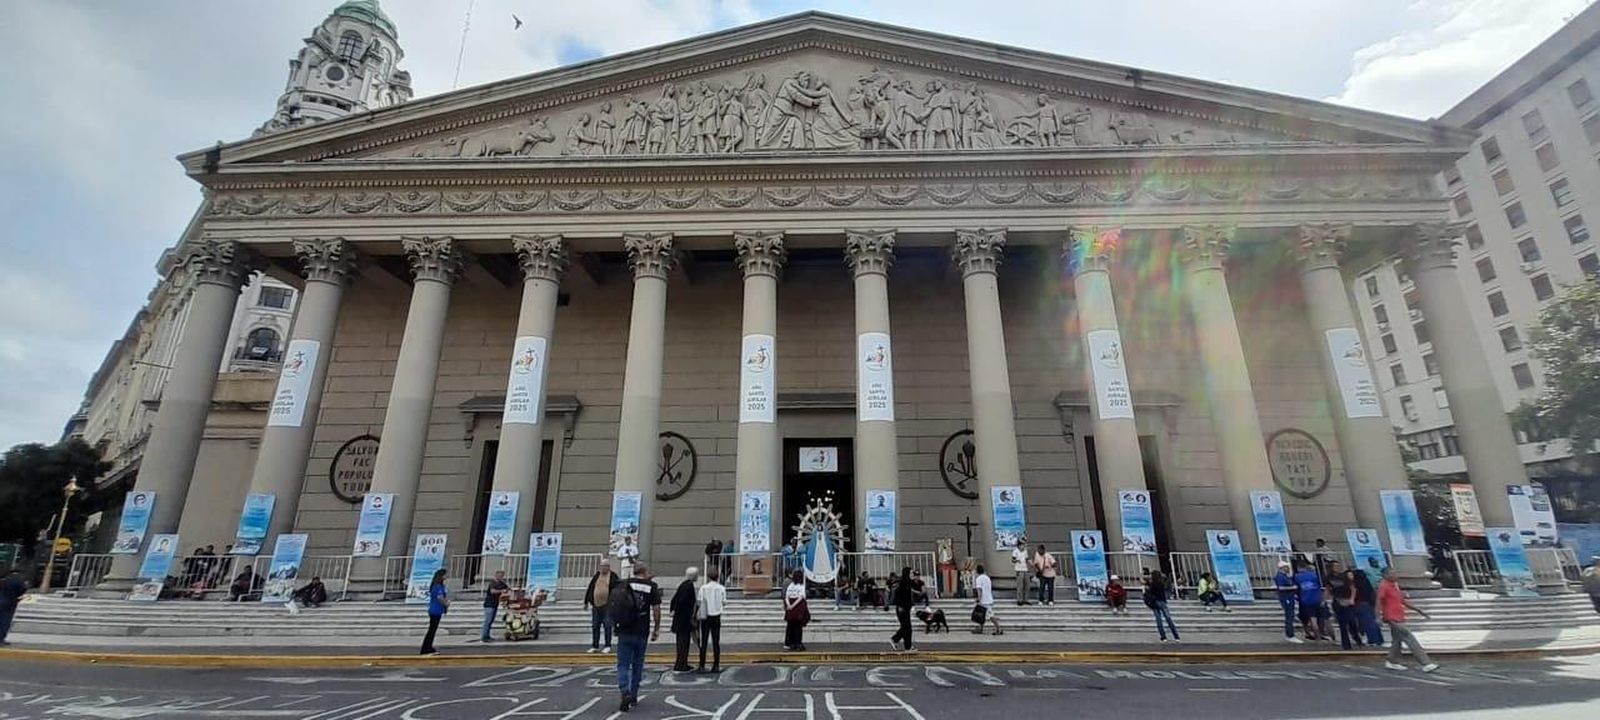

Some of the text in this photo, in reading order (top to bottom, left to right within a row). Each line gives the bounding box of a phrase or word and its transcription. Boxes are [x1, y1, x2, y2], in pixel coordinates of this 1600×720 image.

[748, 403, 766, 411] 2025
[868, 401, 886, 409] 2025
[1110, 399, 1128, 407] 2025
